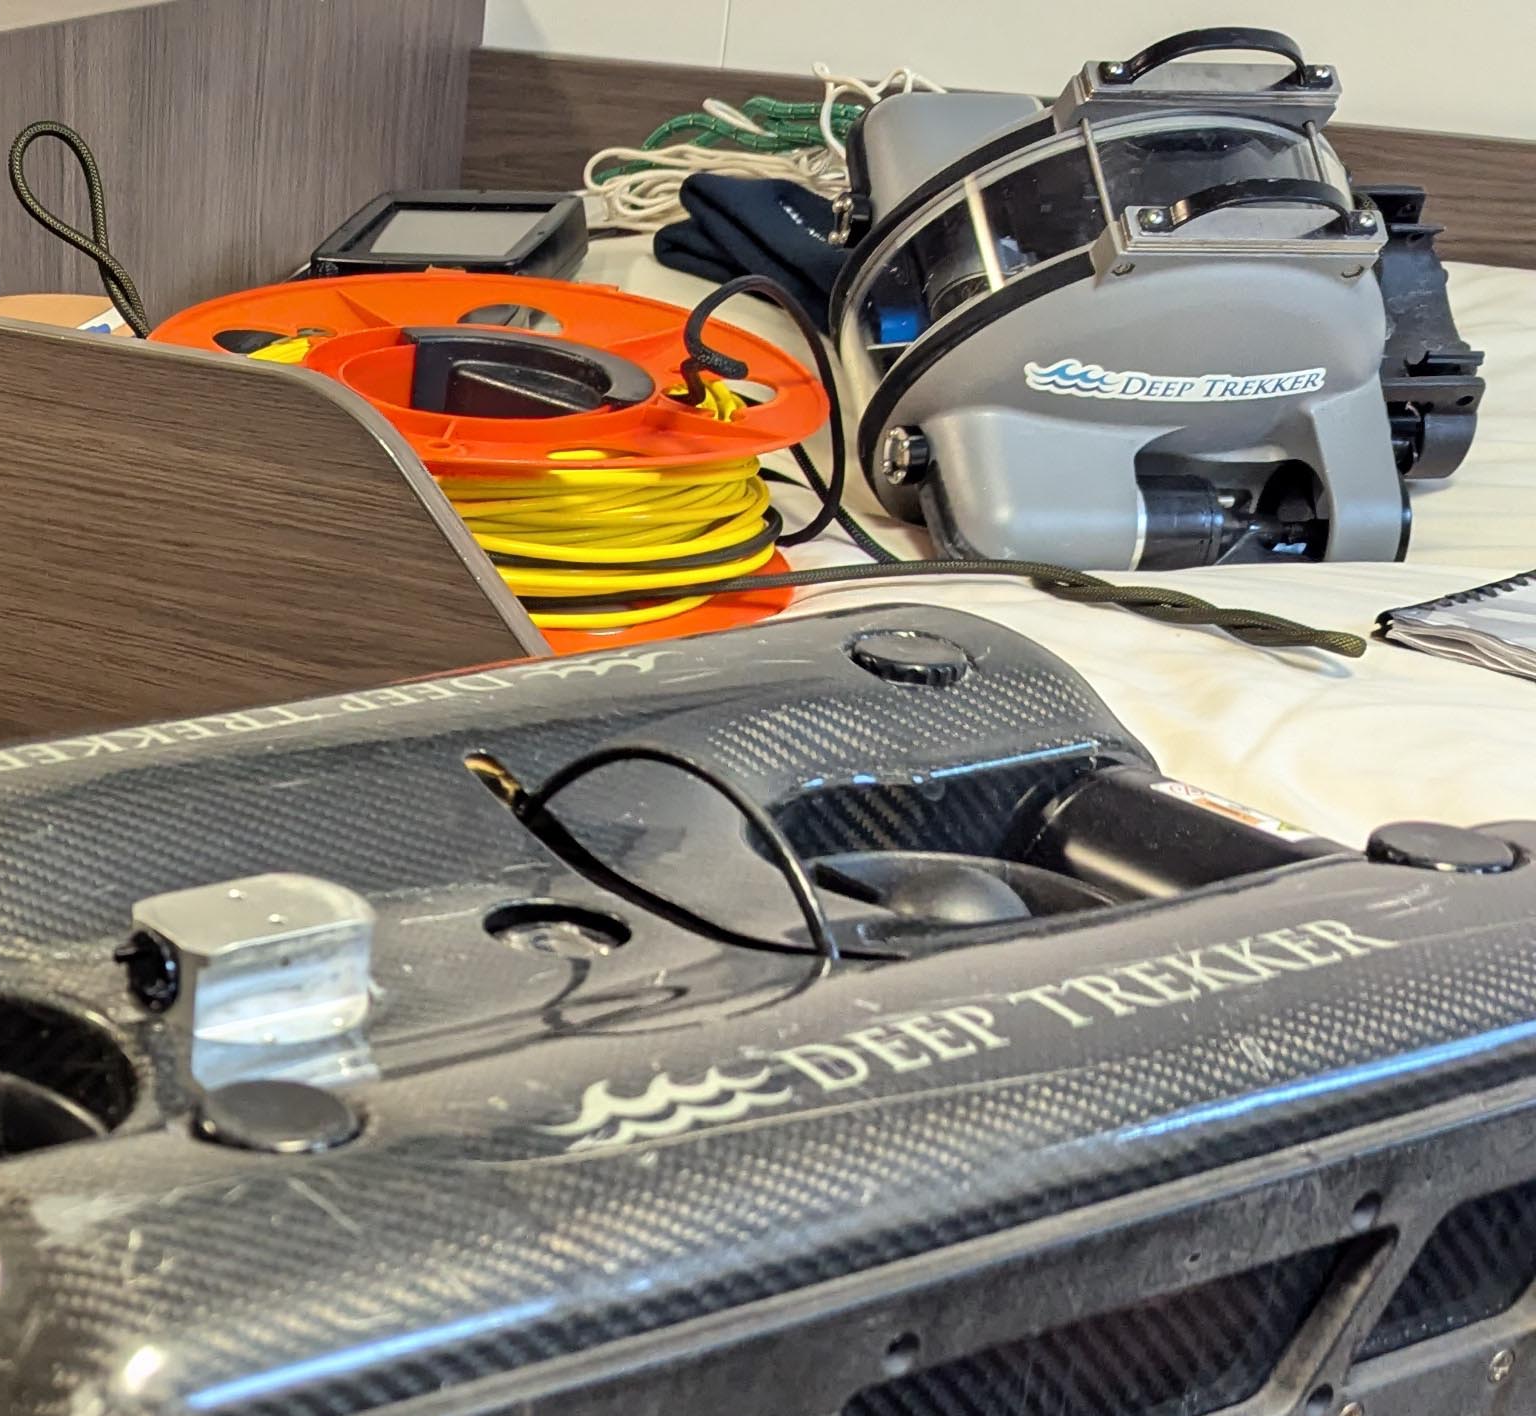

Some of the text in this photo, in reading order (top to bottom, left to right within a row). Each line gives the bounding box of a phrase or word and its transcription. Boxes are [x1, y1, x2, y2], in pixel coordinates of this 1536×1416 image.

[1119, 372, 1321, 398] DEEP TREKKER
[340, 672, 514, 712] DEEP
[777, 919, 1400, 1092] DEEP TREKKER
